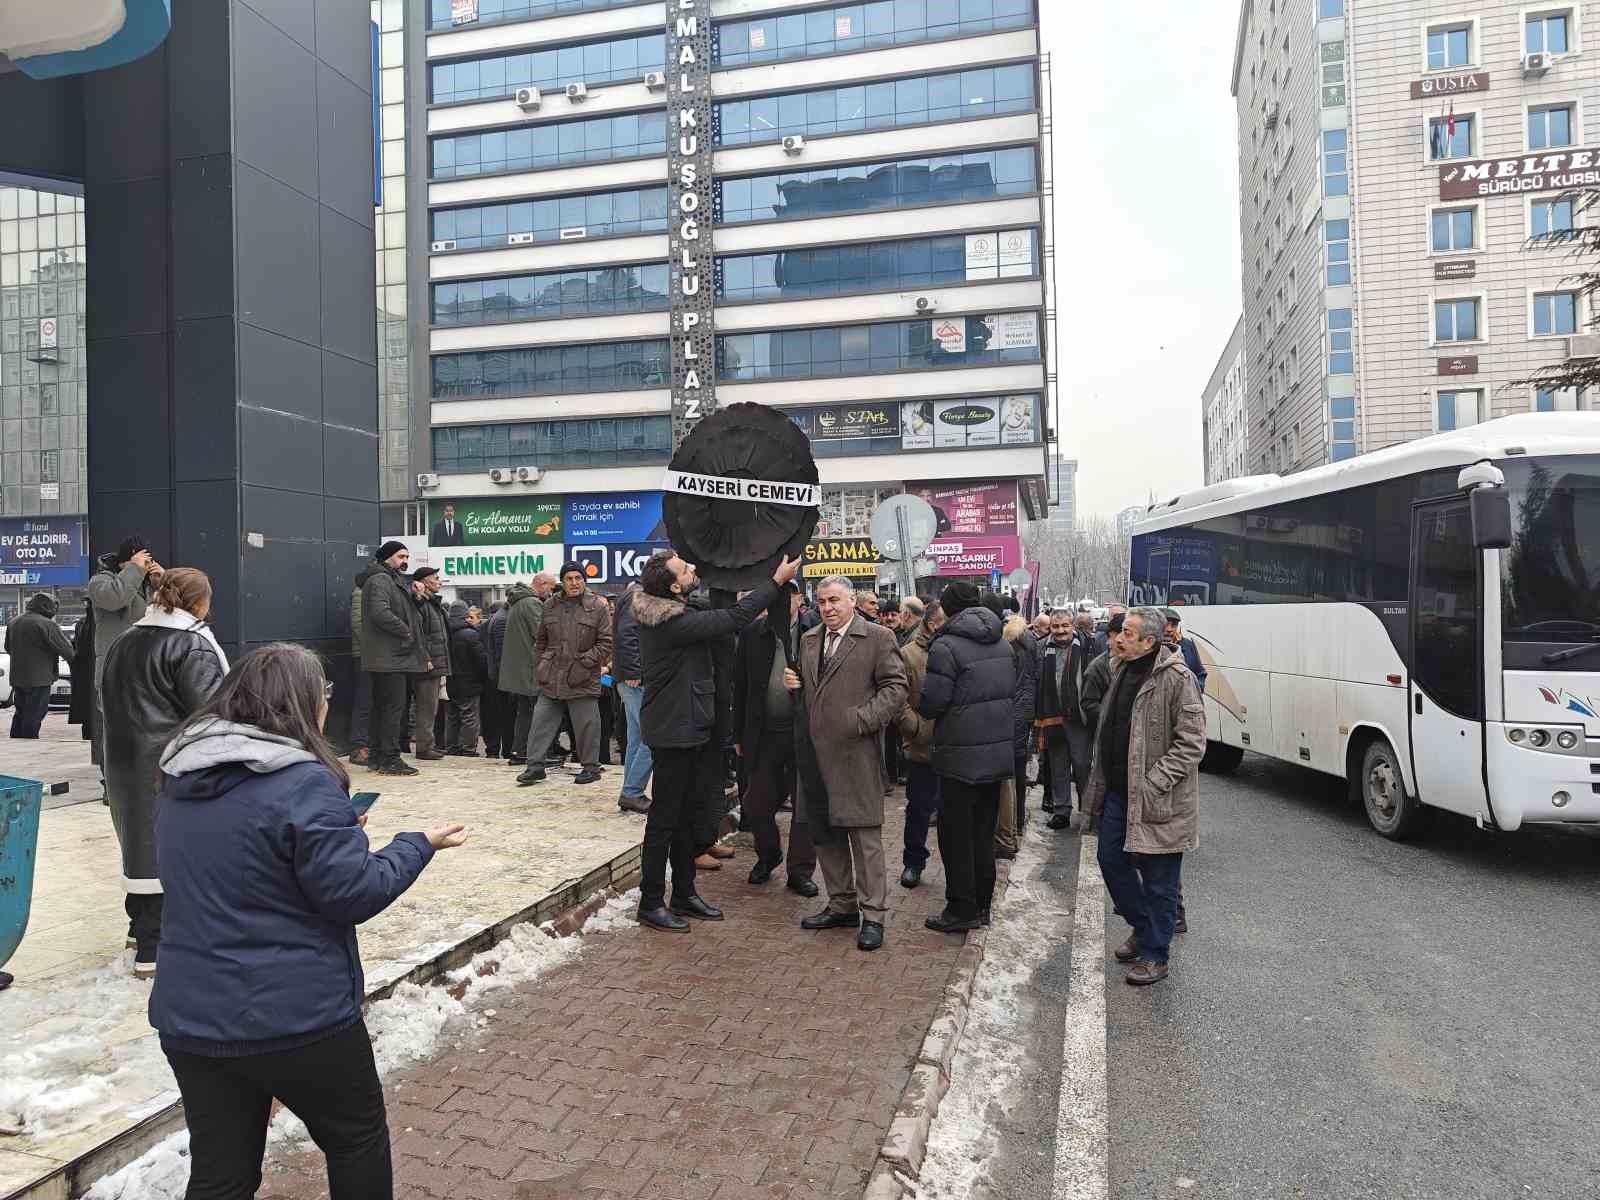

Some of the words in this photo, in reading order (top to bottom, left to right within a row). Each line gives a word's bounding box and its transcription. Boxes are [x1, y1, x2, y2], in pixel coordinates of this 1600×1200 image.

[1435, 75, 1477, 91] USTA
[1478, 174, 1543, 194] SÜRÜCÜ
[679, 107, 699, 296] KUŞOĞLU
[683, 312, 701, 426] PLAZ
[677, 475, 742, 497] KAYSERİ
[746, 483, 813, 503] CEMEVİ
[572, 503, 578, 511] 5
[579, 502, 600, 513] ayda
[615, 499, 640, 510] sahibi
[465, 512, 480, 527] Ev
[482, 510, 532, 525] Almanın
[572, 512, 597, 521] olmak
[599, 512, 614, 523] için
[481, 525, 507, 534] KOLAY
[509, 525, 530, 533] YOLU
[1, 535, 14, 546] EV
[15, 535, 29, 546] DE
[30, 533, 71, 545] ALDIRIR,
[16, 548, 37, 559] OTO
[39, 547, 57, 558] DA.
[949, 554, 997, 563] TASARRUF
[444, 551, 544, 576] EMİNEVİM
